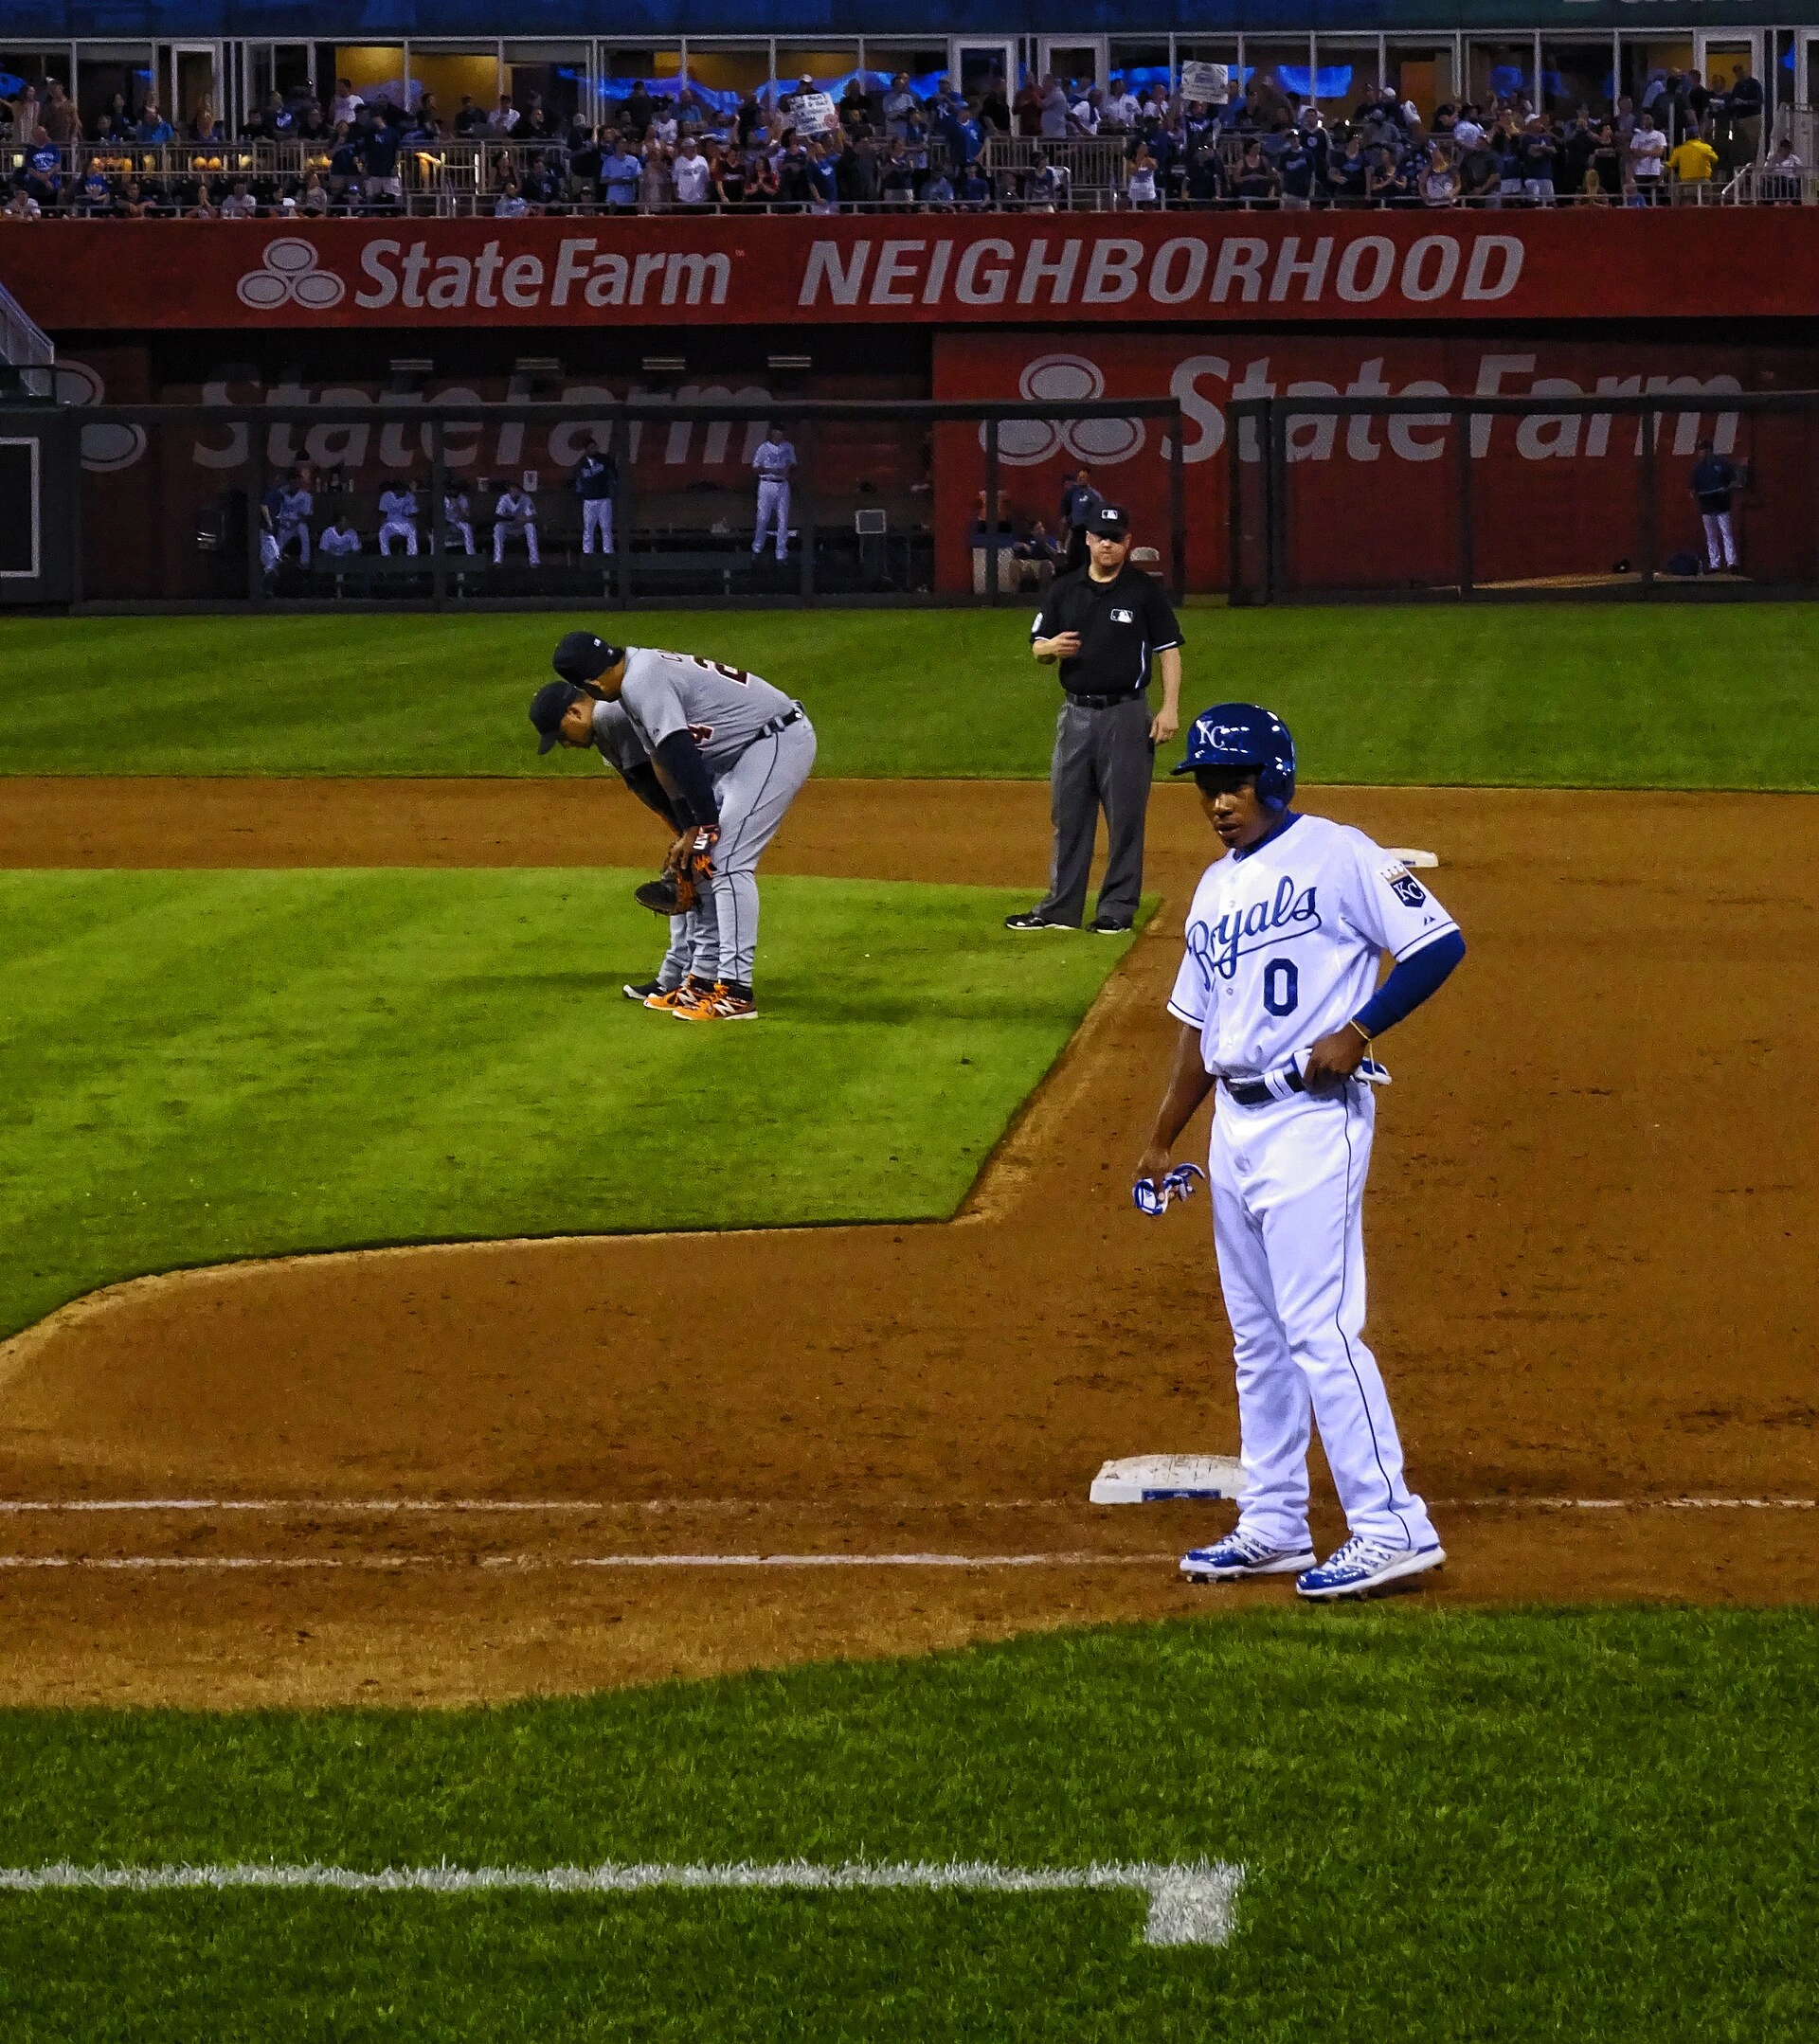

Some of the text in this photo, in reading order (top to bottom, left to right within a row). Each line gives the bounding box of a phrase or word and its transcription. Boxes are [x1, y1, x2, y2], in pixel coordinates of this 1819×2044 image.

[798, 235, 1524, 306] NEIGHBORHOOD
[1393, 881, 1424, 901] KC
[1264, 958, 1298, 1016] 0
